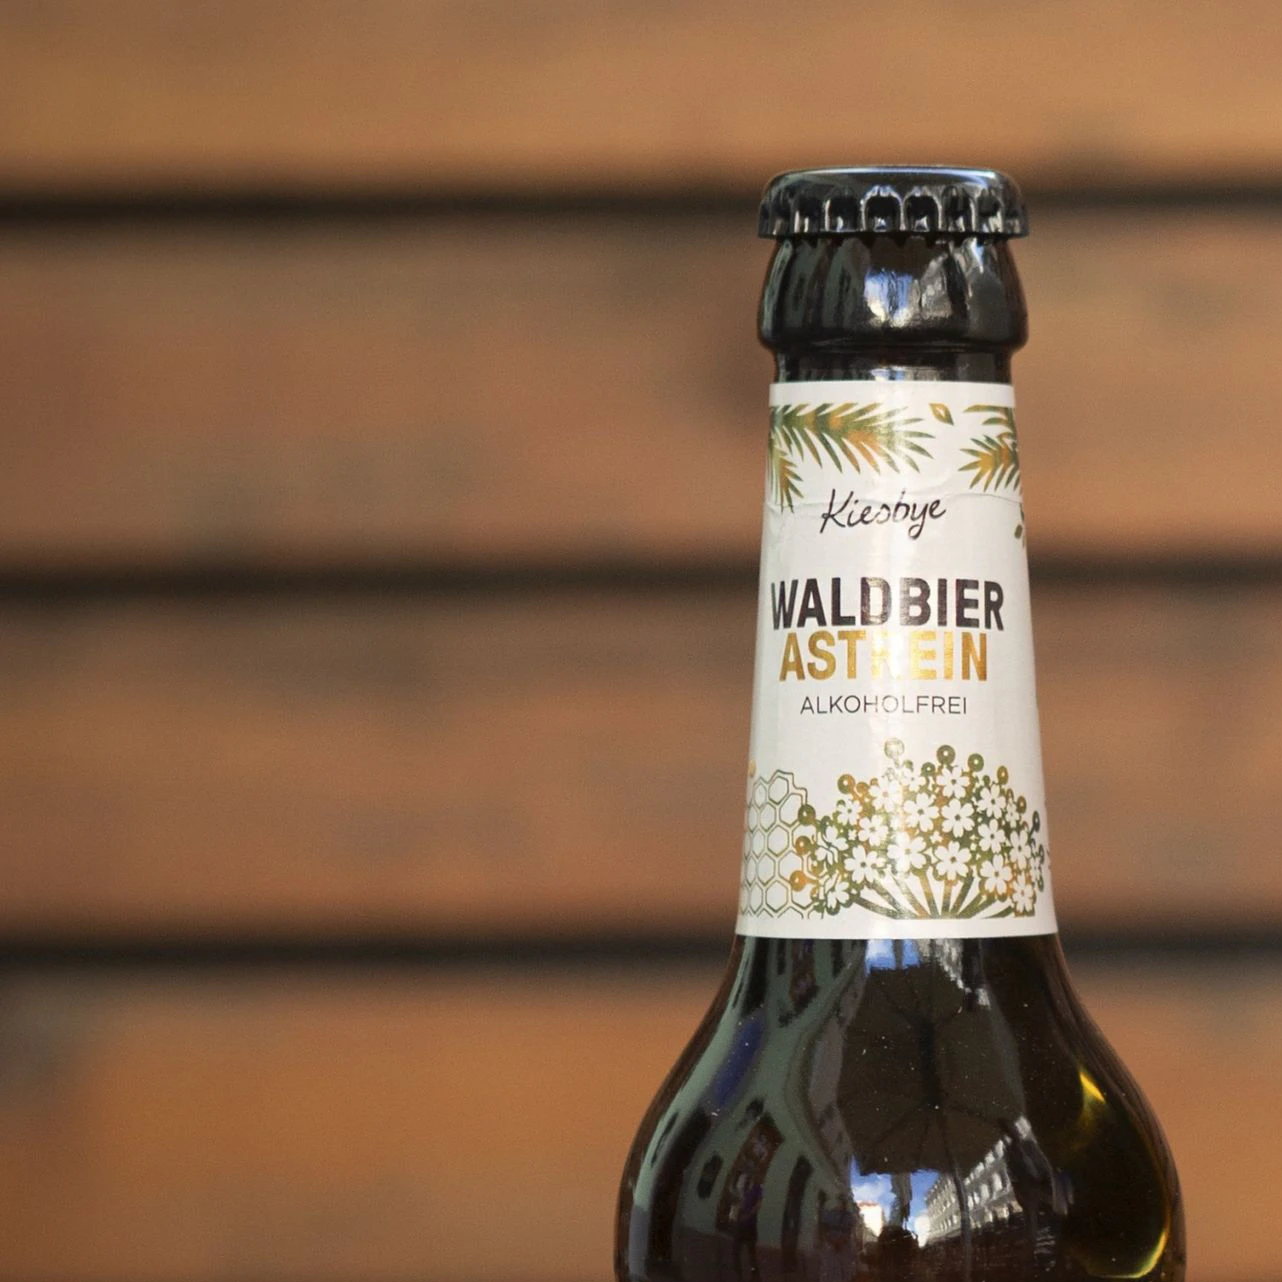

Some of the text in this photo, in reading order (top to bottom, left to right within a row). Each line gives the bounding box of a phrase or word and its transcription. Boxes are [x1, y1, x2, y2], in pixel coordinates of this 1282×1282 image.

[820, 488, 946, 540] Kiesbye
[771, 576, 1004, 631] WALDBIER
[779, 629, 988, 682] ASTREIN
[800, 694, 967, 715] ALKOHOLFREI
